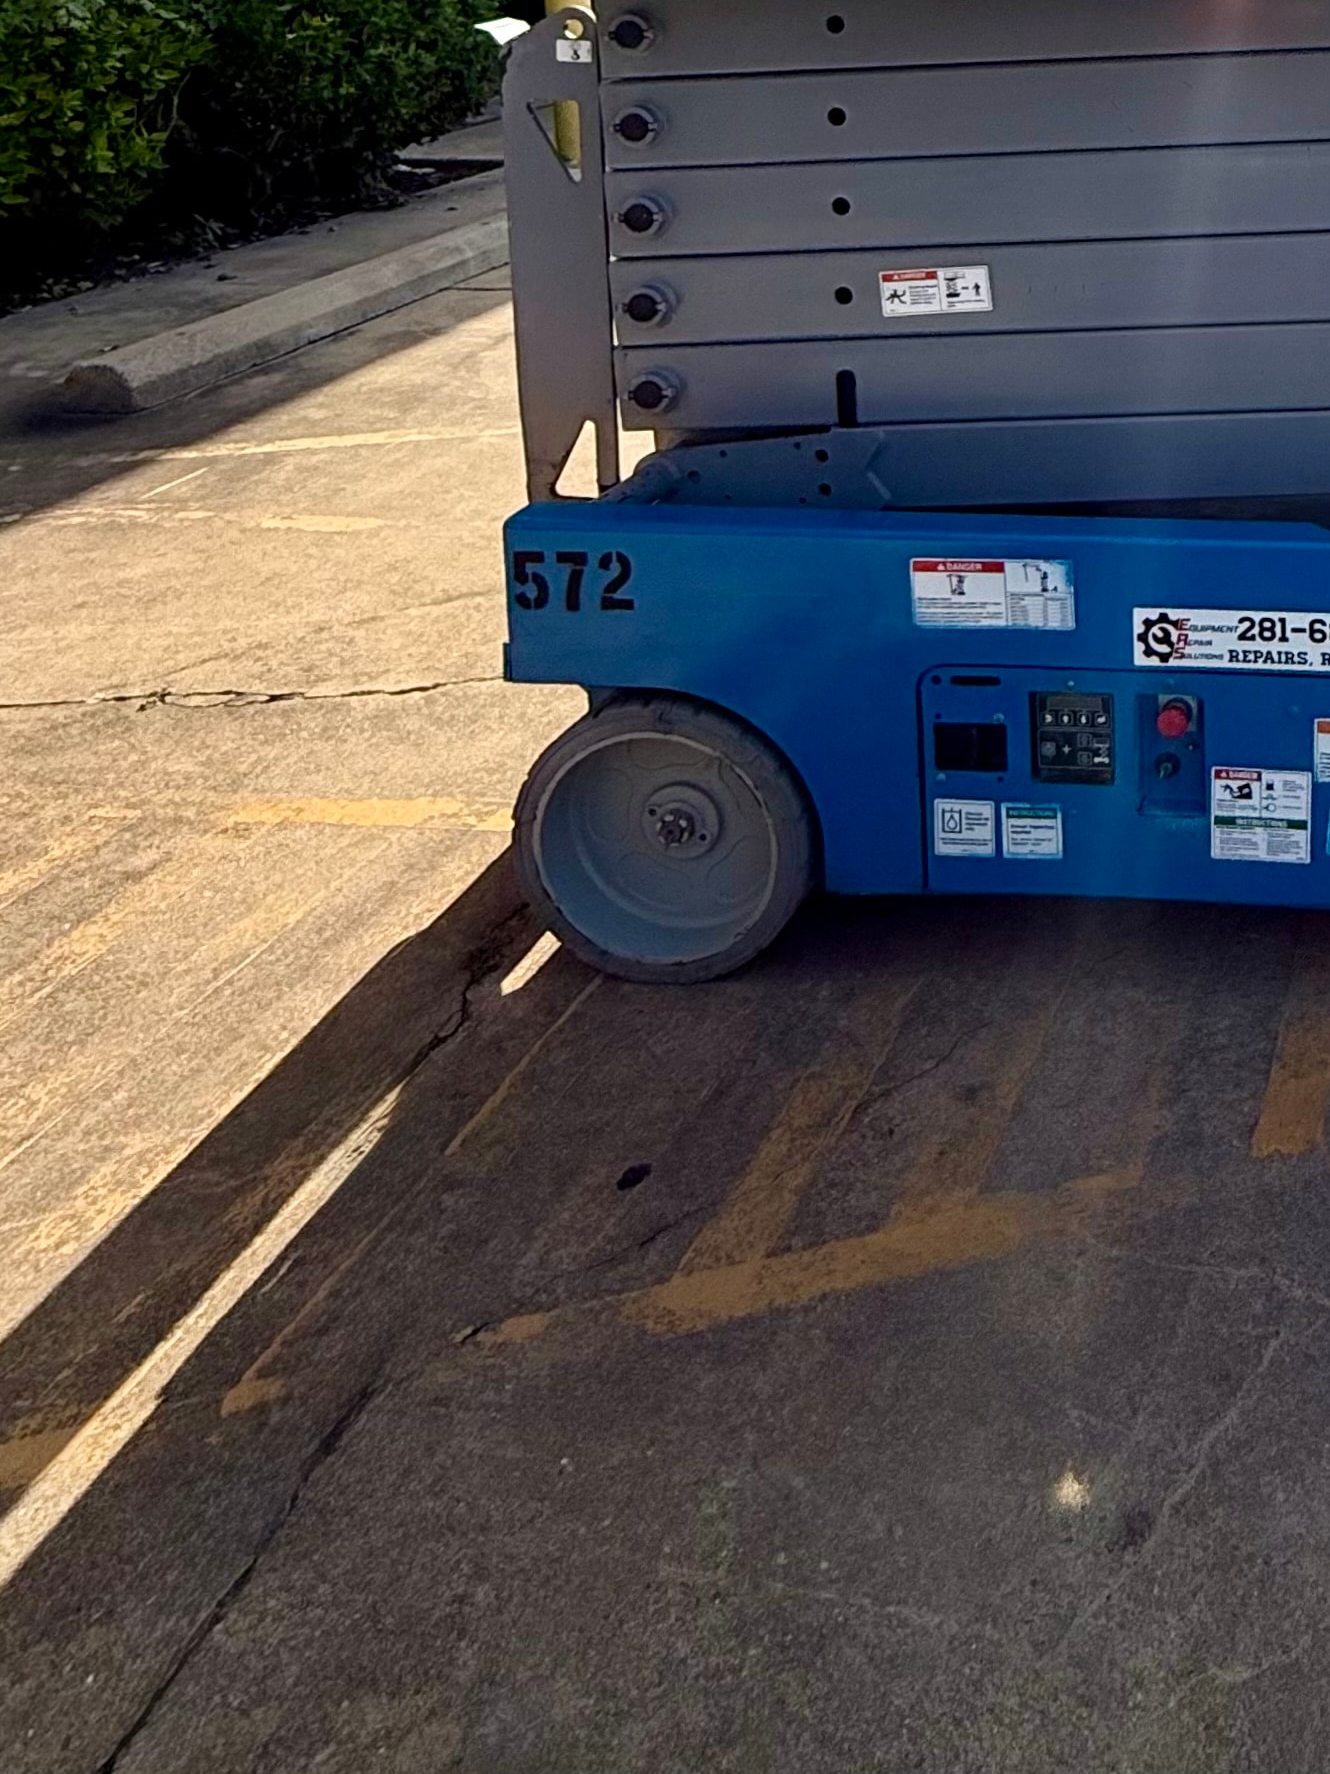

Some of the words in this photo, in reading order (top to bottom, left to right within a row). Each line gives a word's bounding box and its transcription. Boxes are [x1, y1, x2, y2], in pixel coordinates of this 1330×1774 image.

[946, 562, 983, 571] DANGER
[512, 550, 635, 612] 572
[1227, 649, 1314, 667] REPAIRS,
